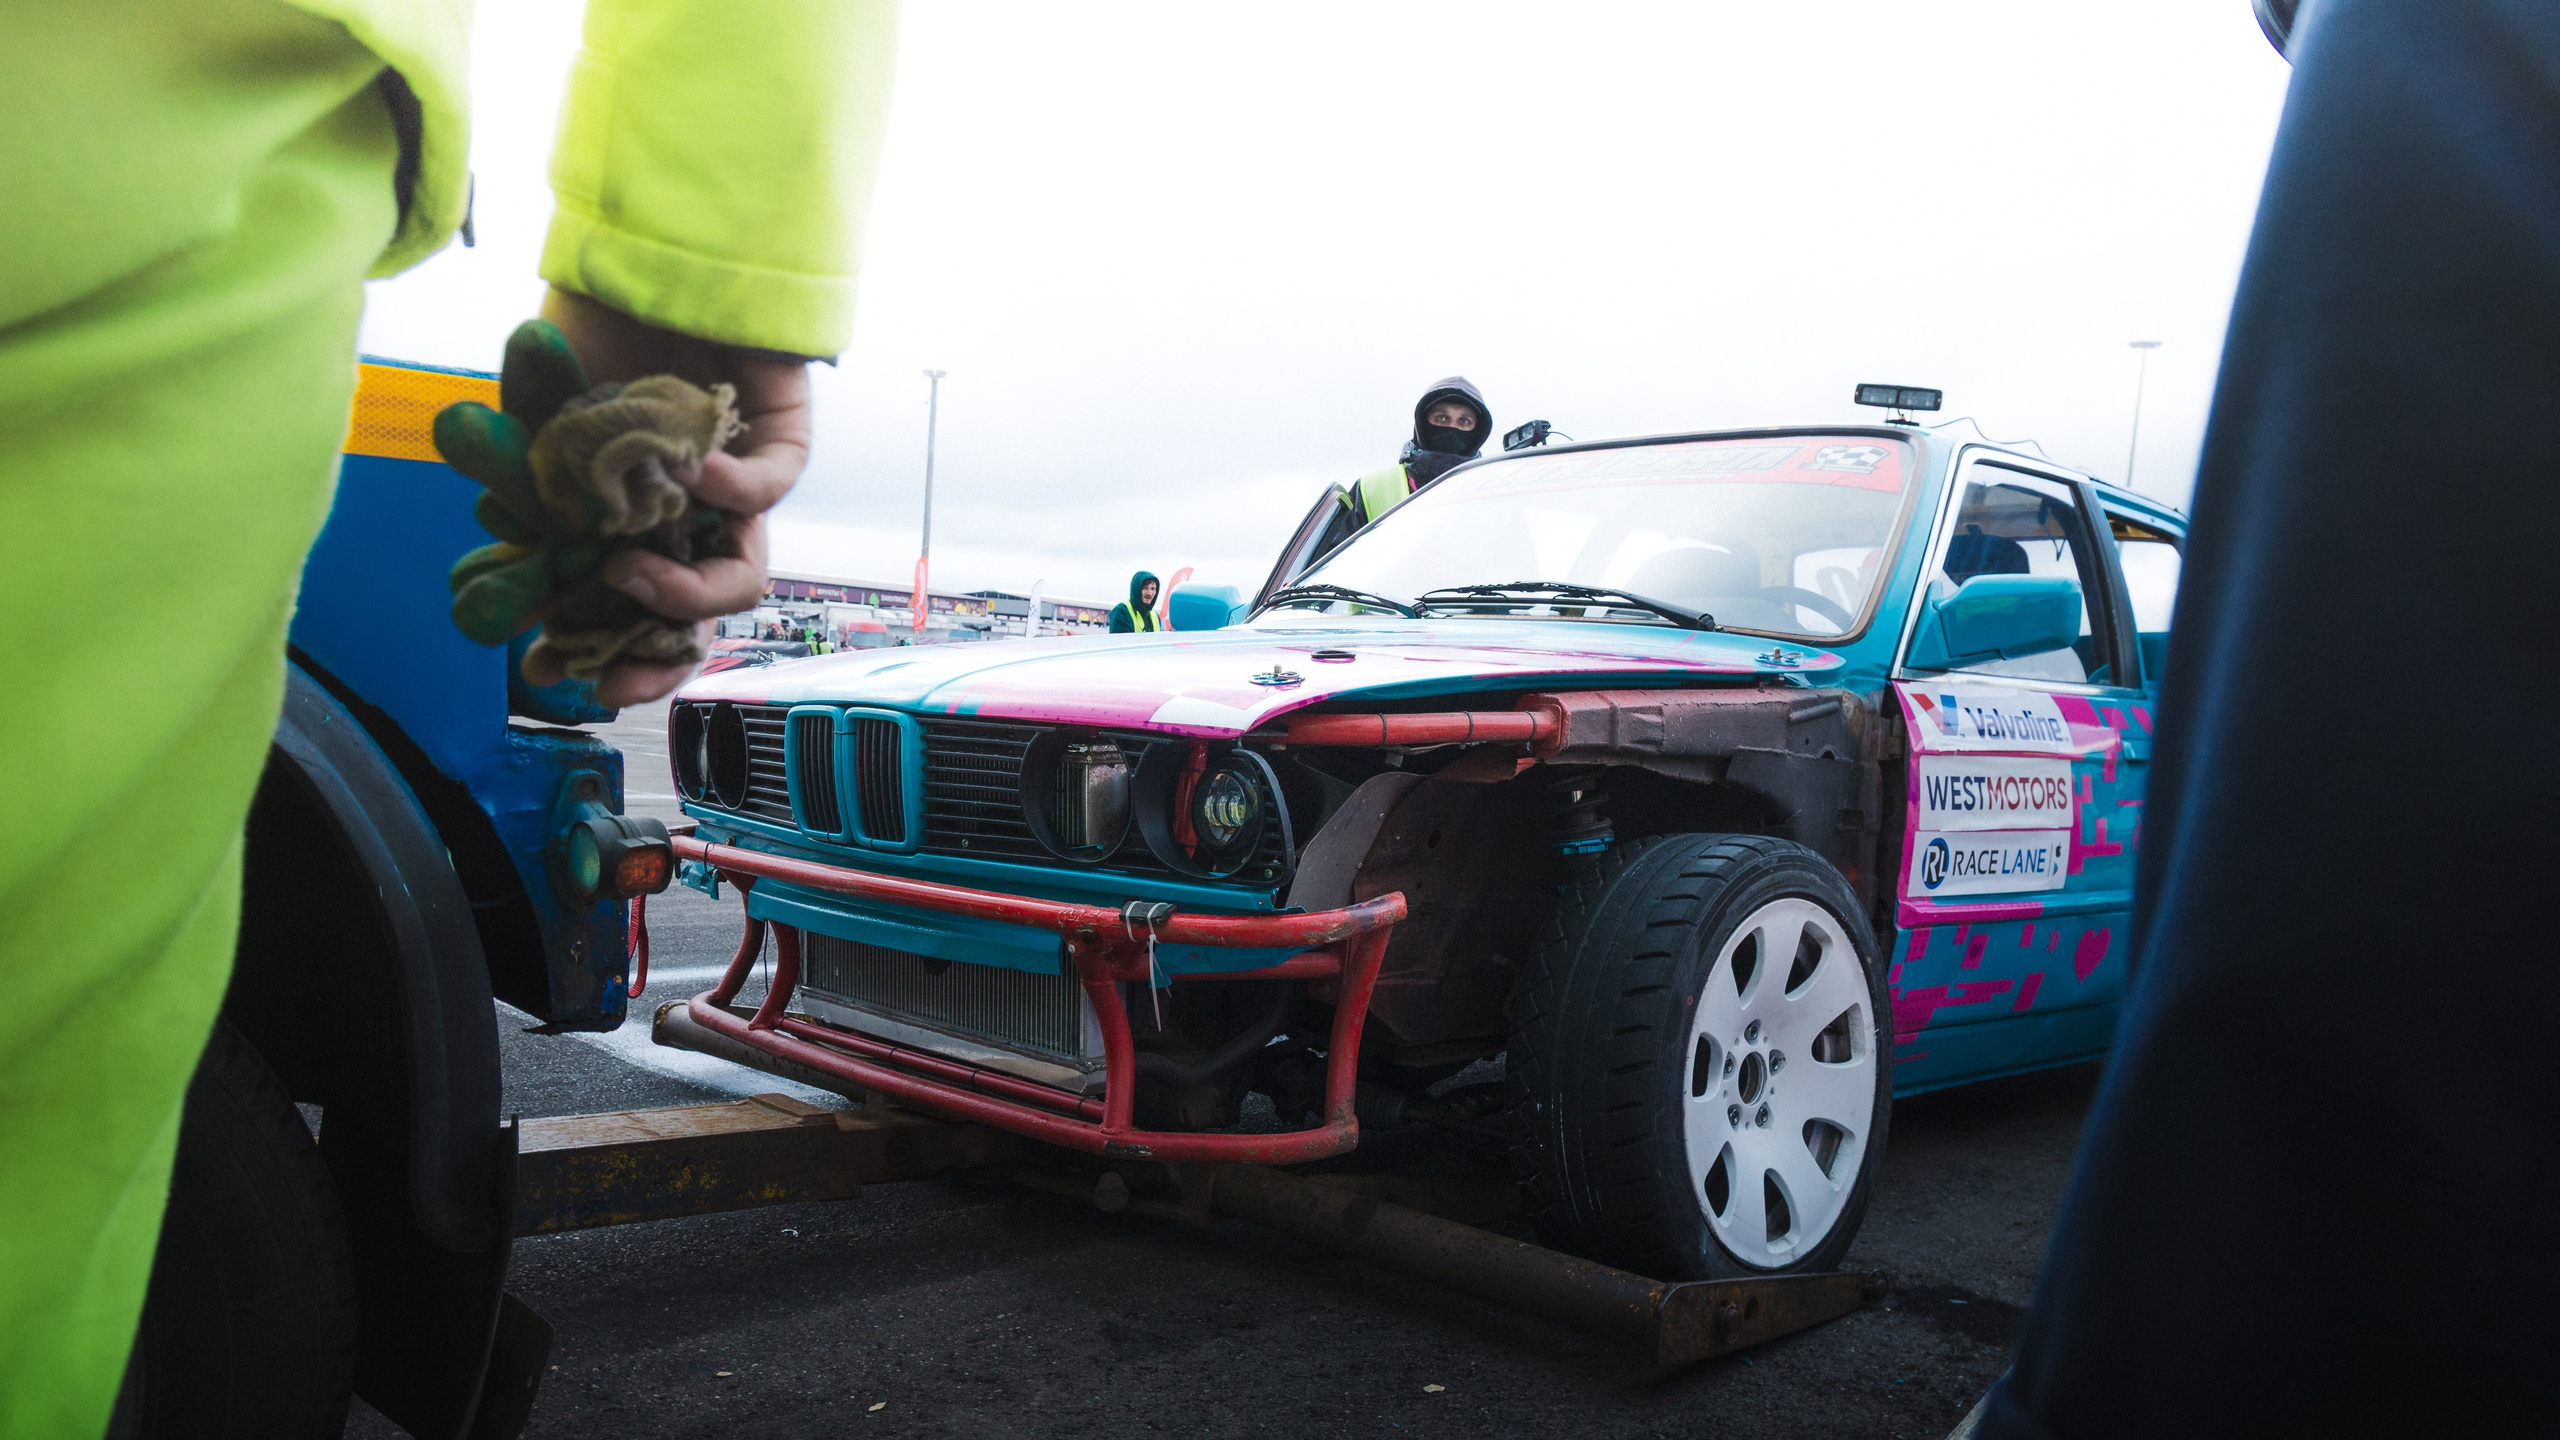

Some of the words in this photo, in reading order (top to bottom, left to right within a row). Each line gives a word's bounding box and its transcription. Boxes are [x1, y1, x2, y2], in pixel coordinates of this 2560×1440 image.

[1964, 706, 2064, 742] Valvoline
[1926, 775, 2067, 811] WESTMOTORS
[1952, 850, 1999, 876] RACE
[2001, 848, 2047, 875] LANE
